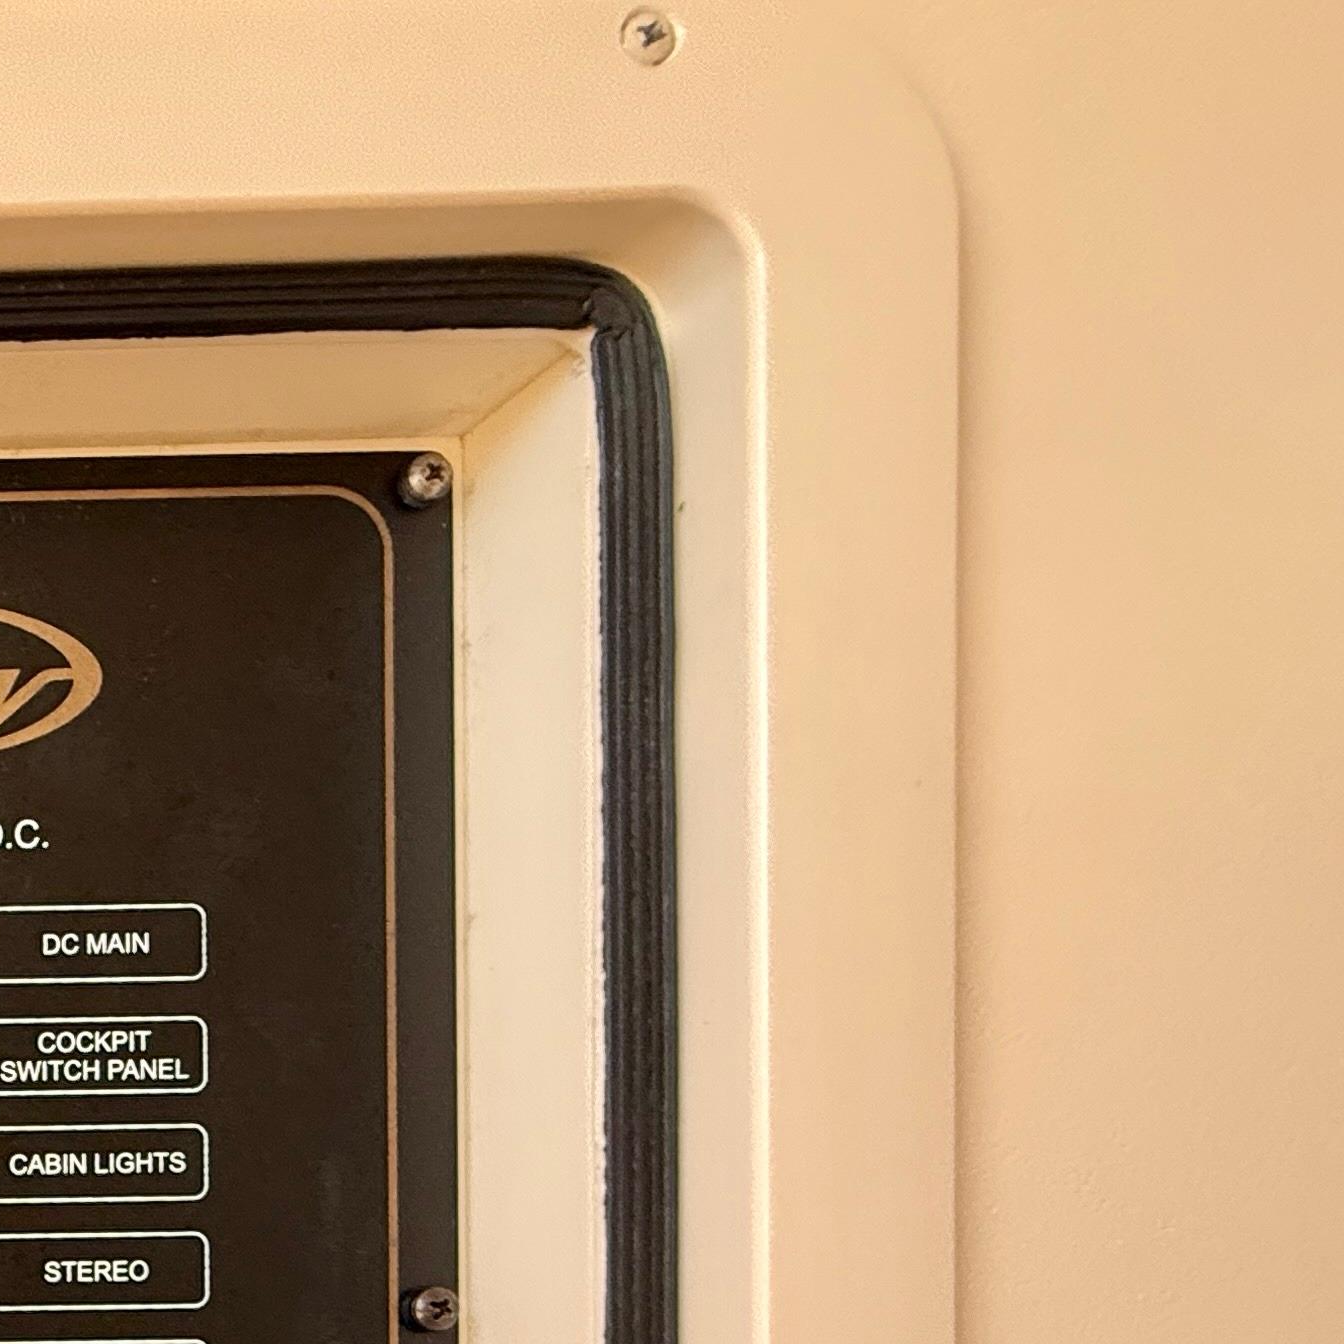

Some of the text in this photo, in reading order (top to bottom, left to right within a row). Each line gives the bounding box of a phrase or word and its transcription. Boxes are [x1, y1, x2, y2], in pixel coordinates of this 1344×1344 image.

[42, 931, 150, 956] DC MAIN
[37, 1029, 153, 1054] COCKPIT
[0, 1057, 190, 1083] SWITCH PANEL
[9, 1151, 187, 1176] CABIN LIGHTS
[43, 1259, 150, 1283] STEREO
